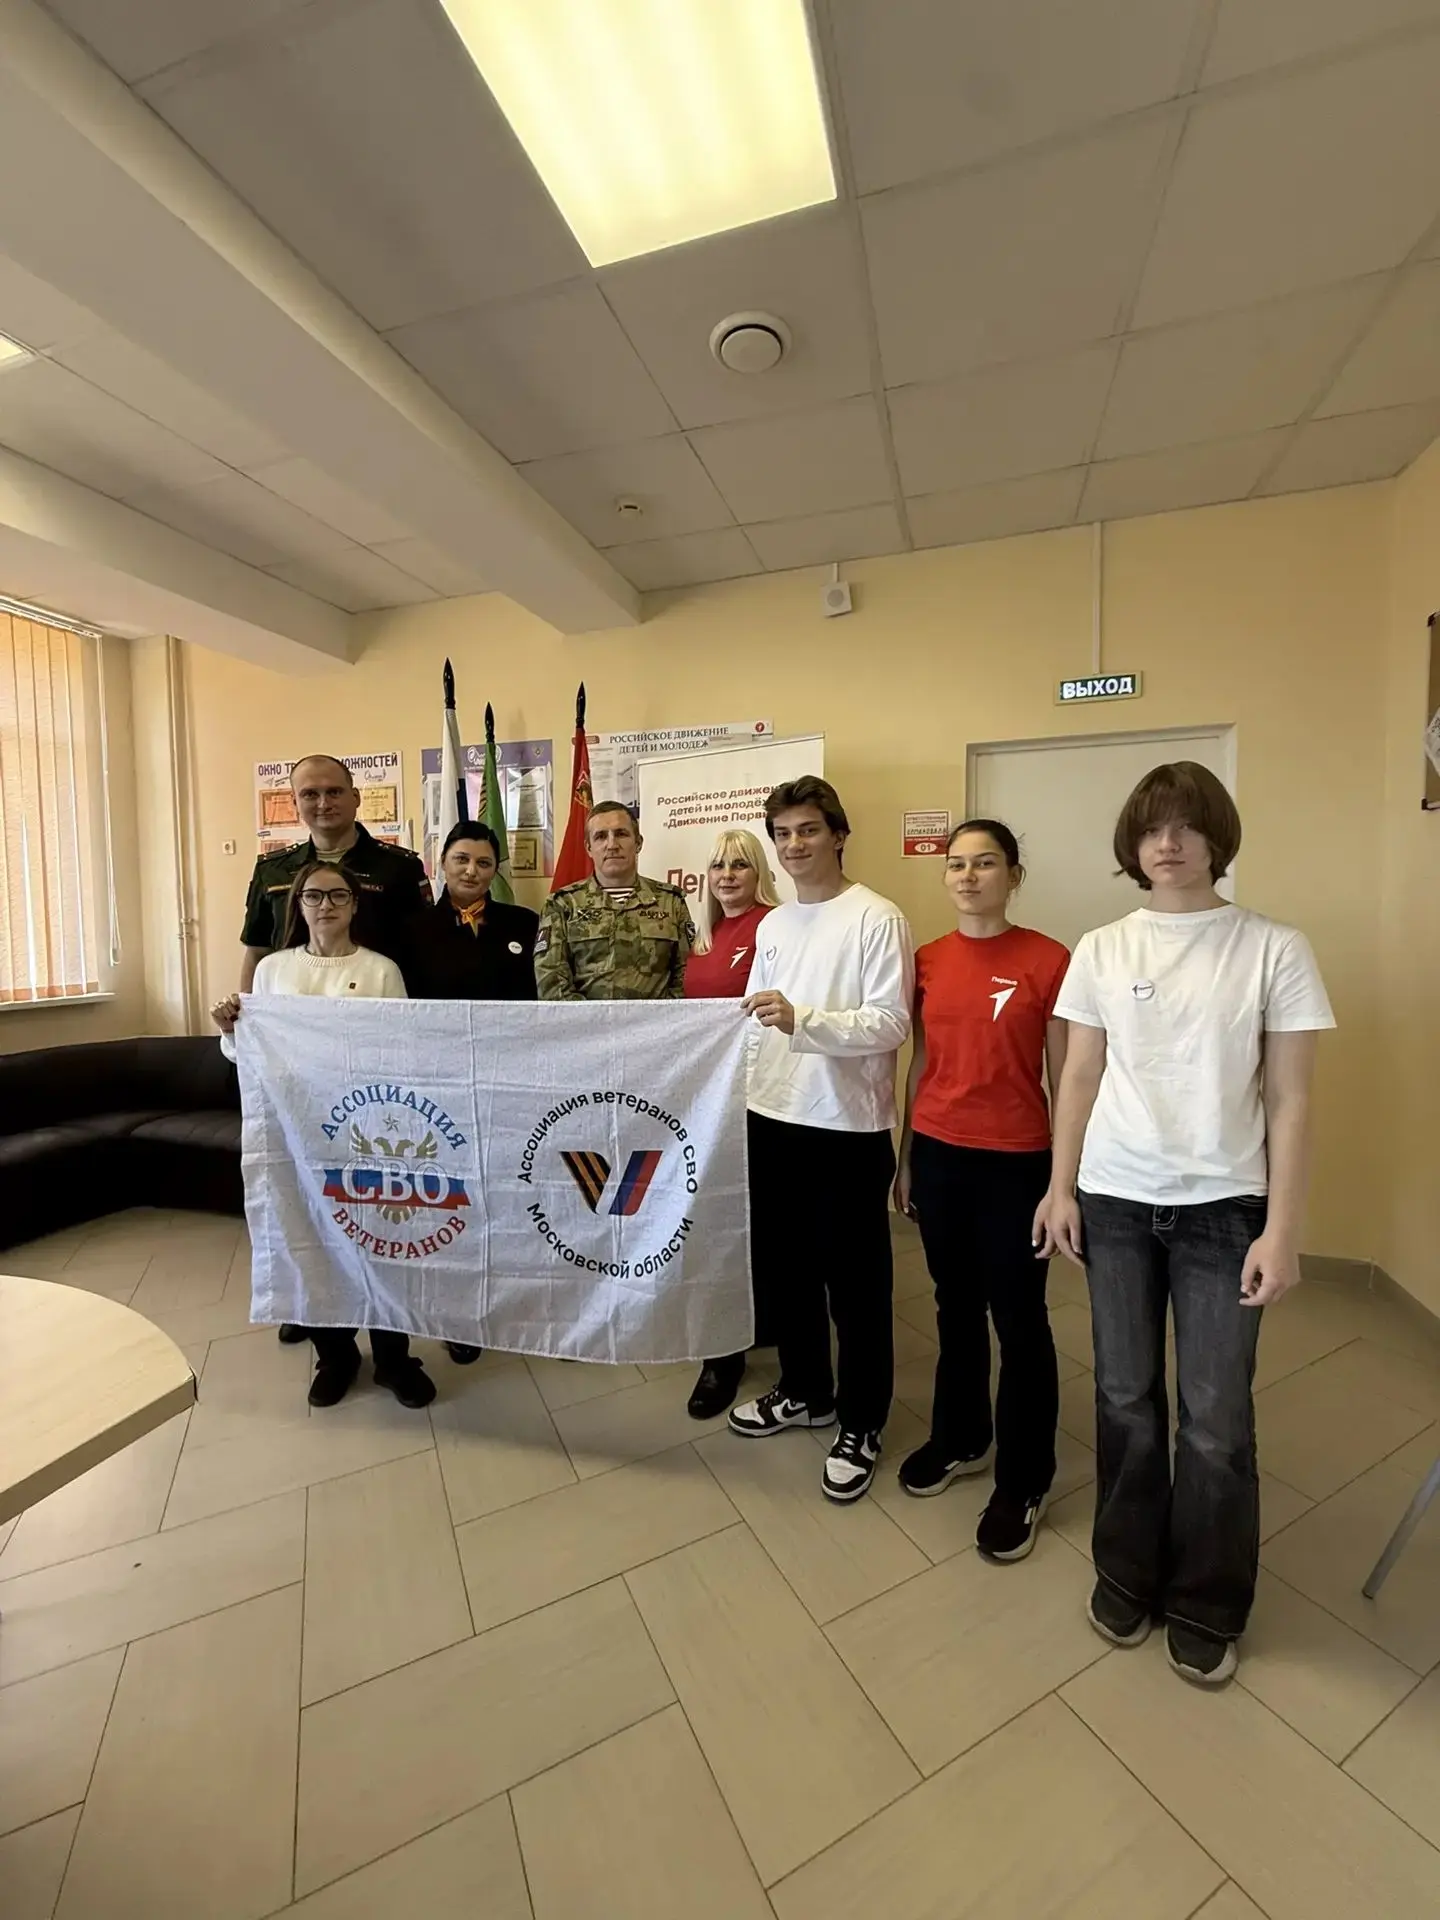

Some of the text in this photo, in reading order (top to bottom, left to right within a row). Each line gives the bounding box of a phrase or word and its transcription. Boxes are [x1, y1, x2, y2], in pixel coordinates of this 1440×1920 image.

[1063, 676, 1133, 699] ВЫХОД
[609, 731, 673, 743] РОССИЙСКОЕ
[674, 727, 729, 740] ДВИЖЕНИЕ
[619, 743, 648, 754] ДЕТЕЙ
[650, 743, 657, 752] И
[258, 763, 282, 776] ОКНО
[657, 790, 727, 806] Российское
[669, 803, 703, 817] детей
[704, 803, 713, 812] и
[920, 843, 931, 851] 01
[321, 1084, 468, 1150] АССОЦИАЦИЯ
[517, 1091, 698, 1194] Ассоциация ветеранов СВО
[341, 1156, 450, 1205] СВО
[332, 1207, 466, 1260] ВЕТЕРАНОВ
[527, 1202, 694, 1279] Московской области
